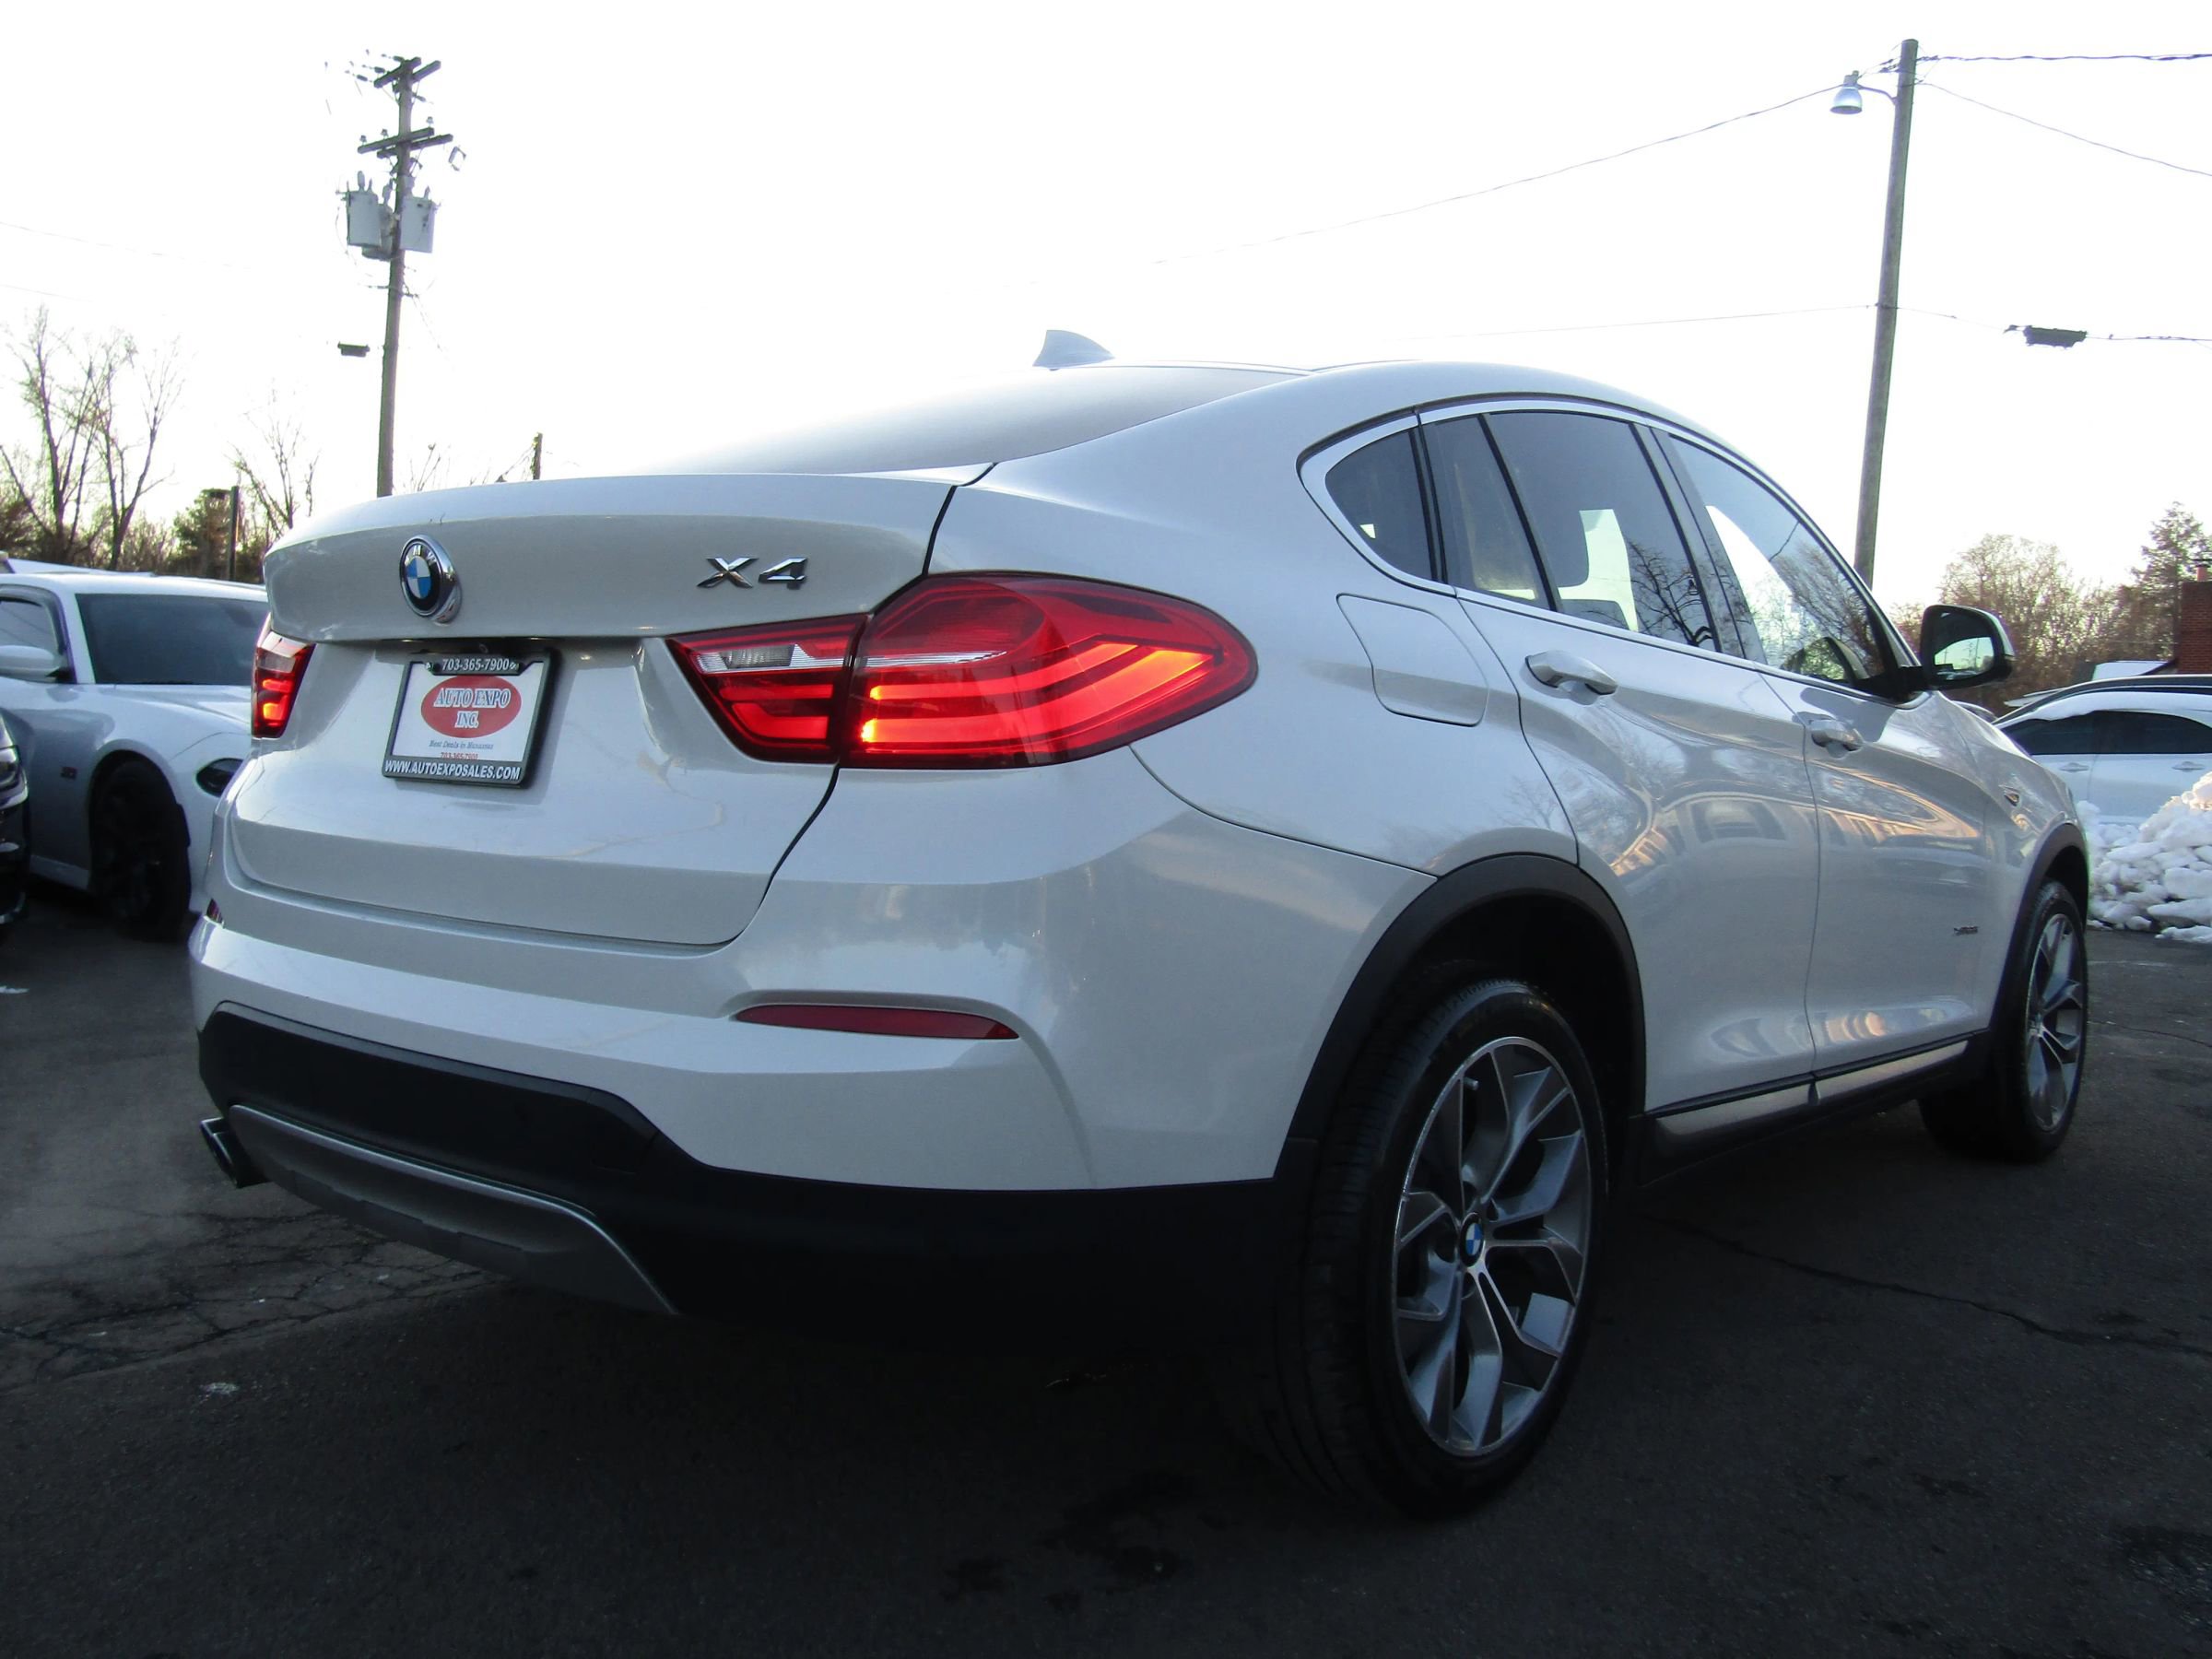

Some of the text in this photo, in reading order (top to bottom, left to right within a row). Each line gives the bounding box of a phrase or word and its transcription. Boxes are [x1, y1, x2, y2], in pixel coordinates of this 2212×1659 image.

[697, 557, 808, 590] X4
[441, 658, 511, 671] 703-365-7900
[434, 688, 512, 708] AUTO EXPO
[384, 760, 521, 780] WWW.AUTOEXPOSALES.COM
